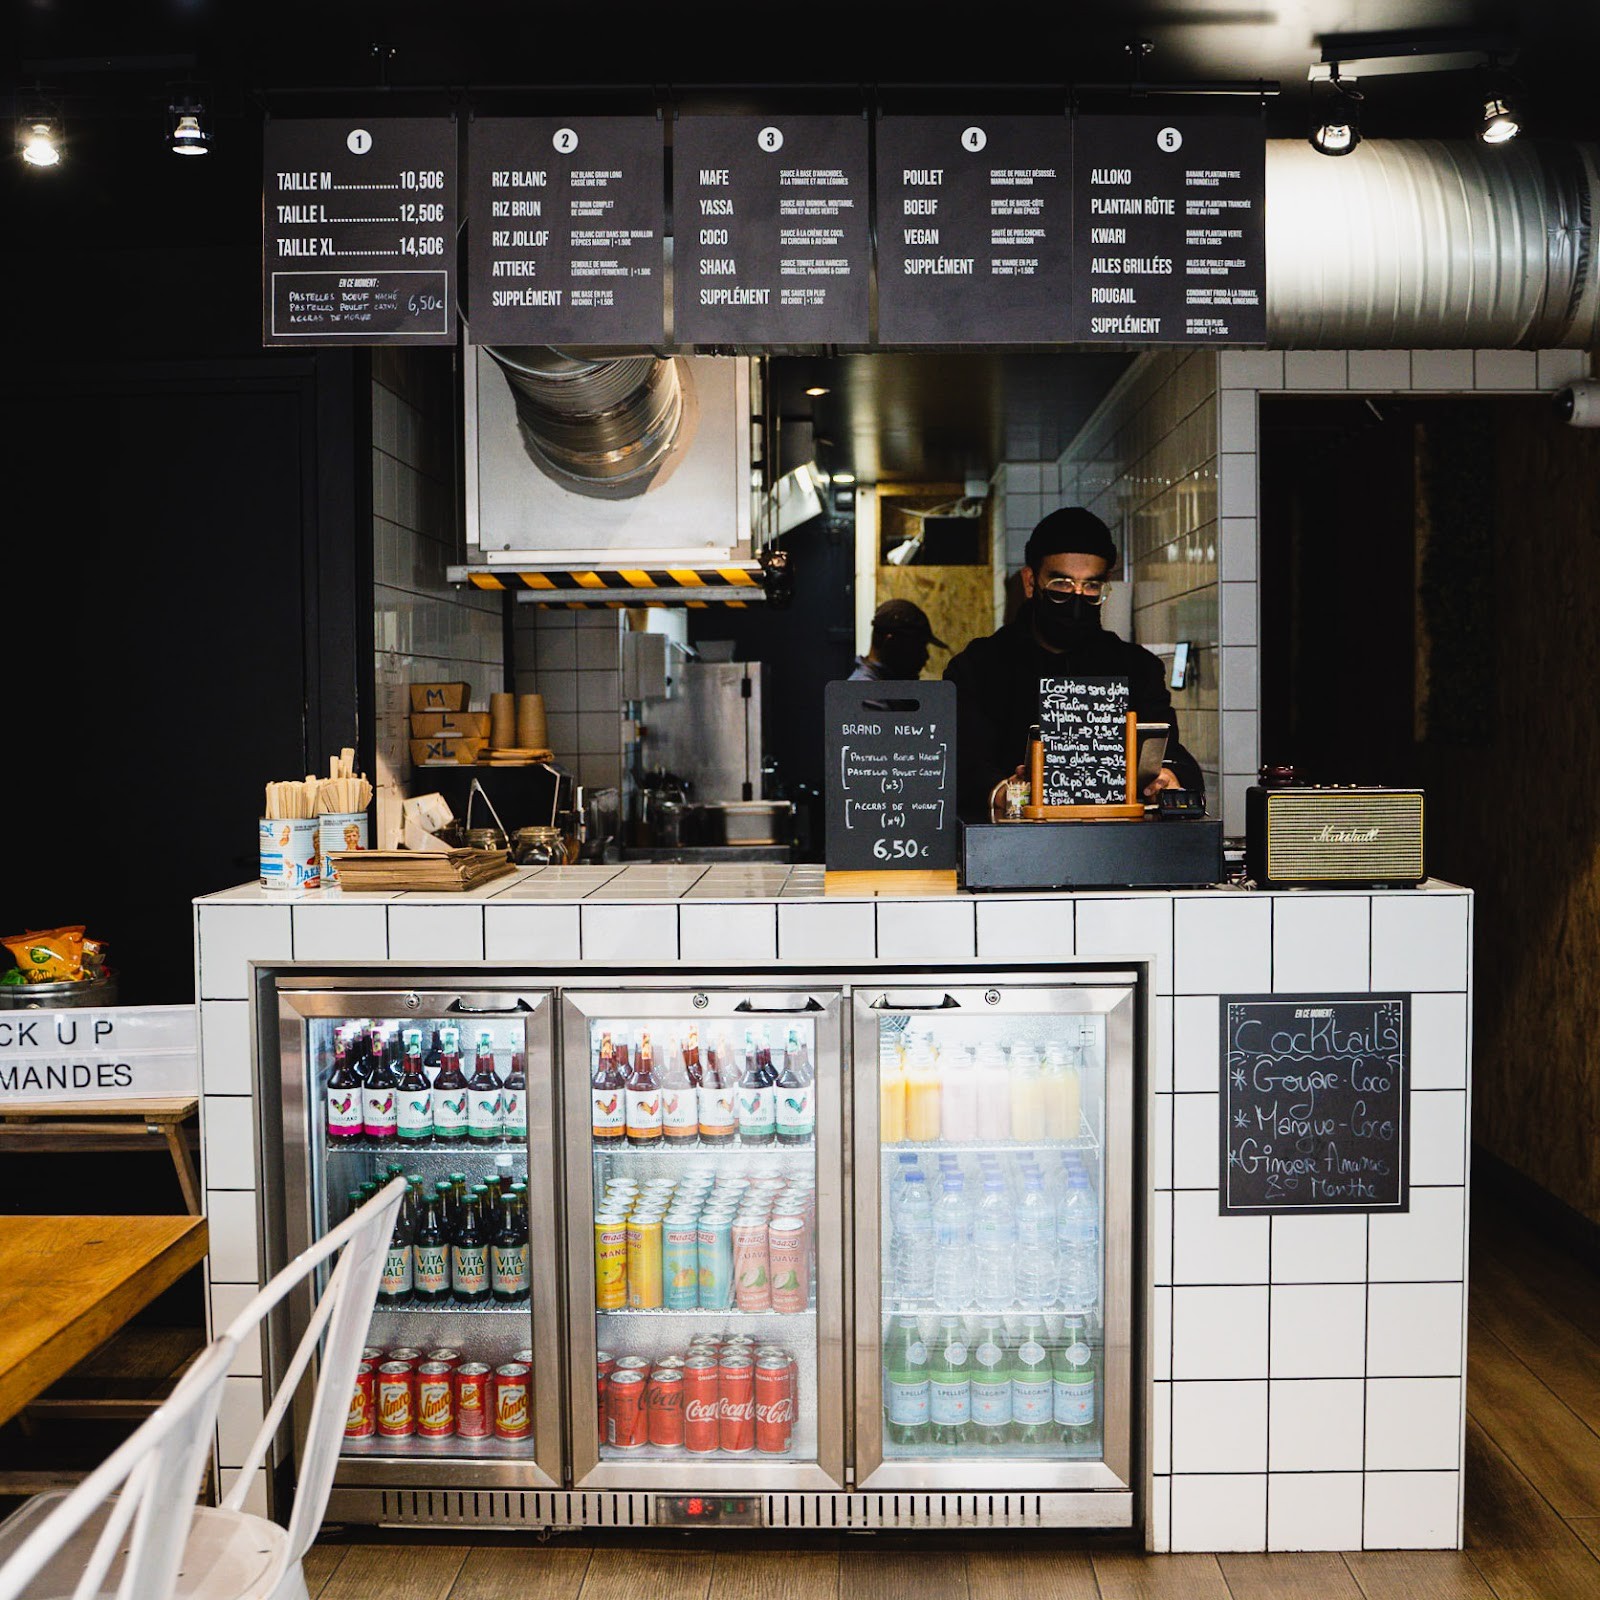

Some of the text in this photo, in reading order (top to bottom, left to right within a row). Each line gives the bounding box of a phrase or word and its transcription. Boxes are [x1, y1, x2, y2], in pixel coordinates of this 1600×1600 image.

[355, 135, 362, 148] 1
[562, 134, 570, 148] 2
[766, 132, 774, 146] 3
[970, 132, 978, 146] 4
[1165, 132, 1173, 147] 5
[277, 172, 317, 190] TAILLE
[400, 171, 444, 192] 10,50€
[492, 172, 547, 186] RIZ BLANC
[700, 170, 729, 186] MAFE
[904, 170, 944, 186] POULET
[1092, 169, 1132, 184] ALLOKO
[492, 202, 541, 216] RIZ BRUN
[700, 200, 734, 215] YASSA
[904, 200, 938, 215] BOEUF
[1092, 196, 1175, 214] PLANTAIN RÔTIE
[277, 205, 317, 223] TAILLE
[400, 204, 444, 224] 12,50€
[492, 231, 549, 246] RIZ JOLLOF
[700, 230, 728, 245] COCO
[904, 229, 939, 244] VEGAN
[1092, 228, 1126, 244] KWARI
[277, 238, 317, 256] TAILLE
[400, 237, 443, 257] 14,50€
[492, 261, 536, 276] ATTIEKE
[700, 260, 736, 274] SHAKA
[904, 256, 974, 275] SUPPLÉMENT
[1092, 256, 1172, 274] AILES GRILLÉES
[492, 288, 562, 306] SUPPLÉMENT
[700, 286, 770, 304] SUPPLÉMENT
[1092, 288, 1136, 304] ROUGAIL
[1092, 315, 1160, 334] SUPPLÉMENT
[427, 688, 445, 706] M
[442, 714, 454, 728] L
[842, 724, 882, 736] BRAND
[894, 725, 924, 736] NEW
[426, 740, 456, 758] XL
[1313, 825, 1379, 843] Marshall
[420, 1255, 444, 1265] VITA
[460, 1256, 484, 1266] VITA
[499, 1256, 523, 1266] VITA
[418, 1264, 446, 1275] MALT
[458, 1265, 486, 1276] MALT
[497, 1264, 525, 1276] MALT
